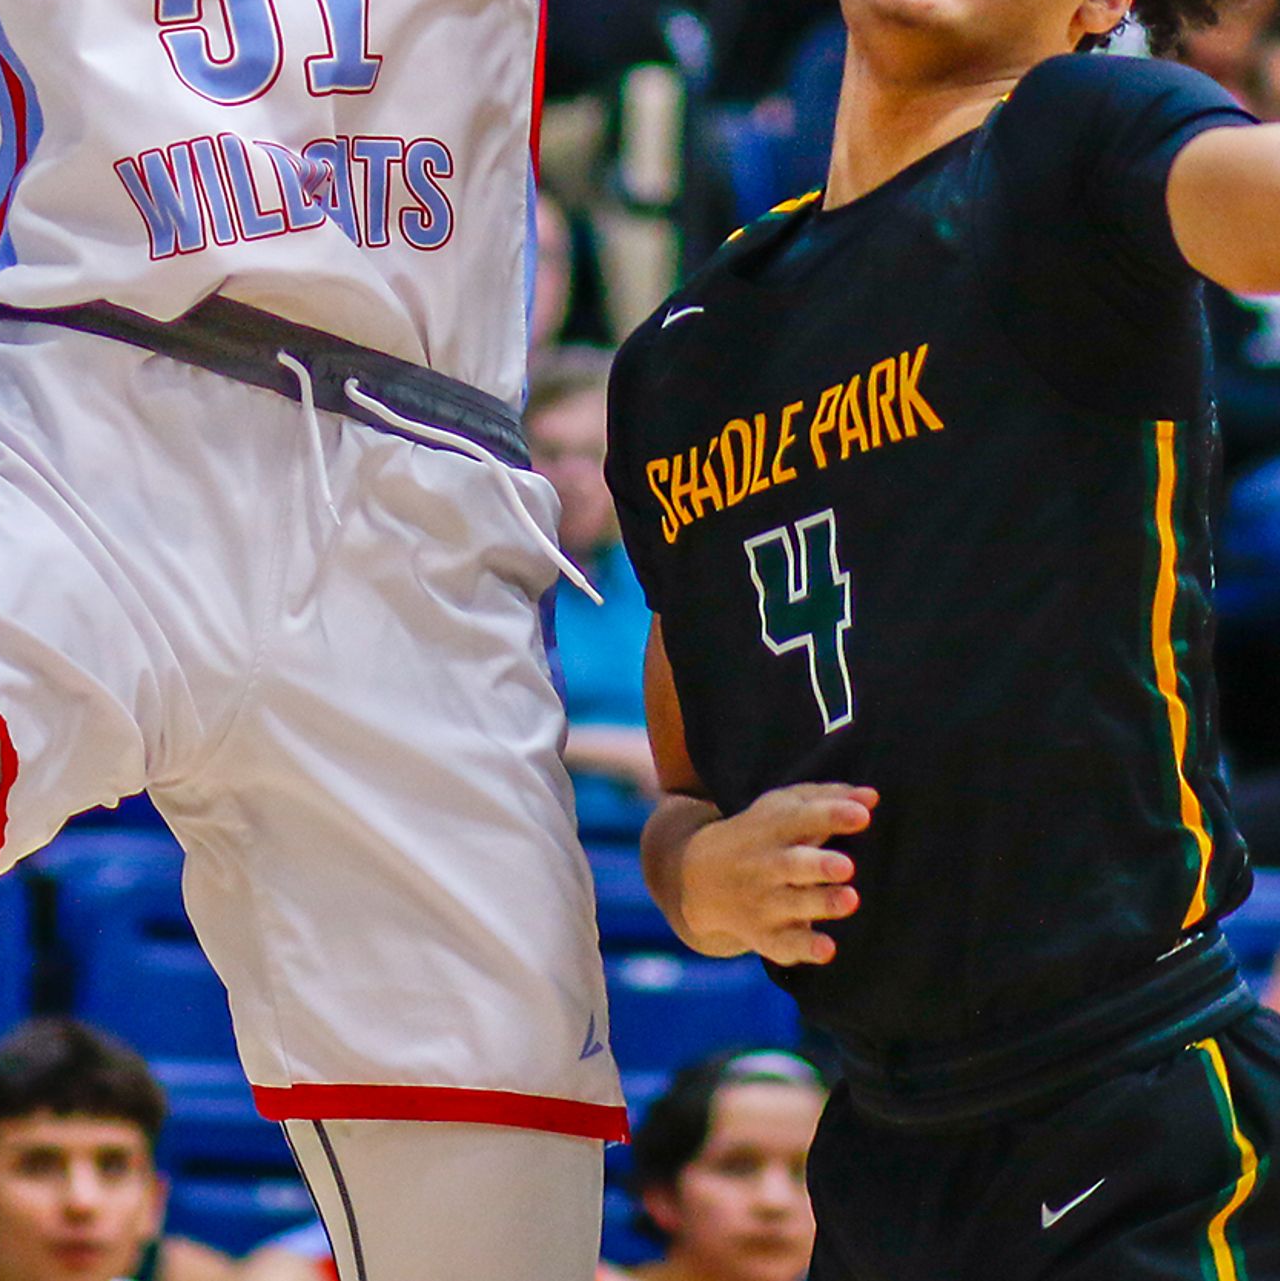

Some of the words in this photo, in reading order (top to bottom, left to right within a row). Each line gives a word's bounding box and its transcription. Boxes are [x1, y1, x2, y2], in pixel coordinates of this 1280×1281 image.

[646, 399, 804, 545] SHADLE
[810, 342, 945, 469] PARK
[743, 508, 853, 735] 4
